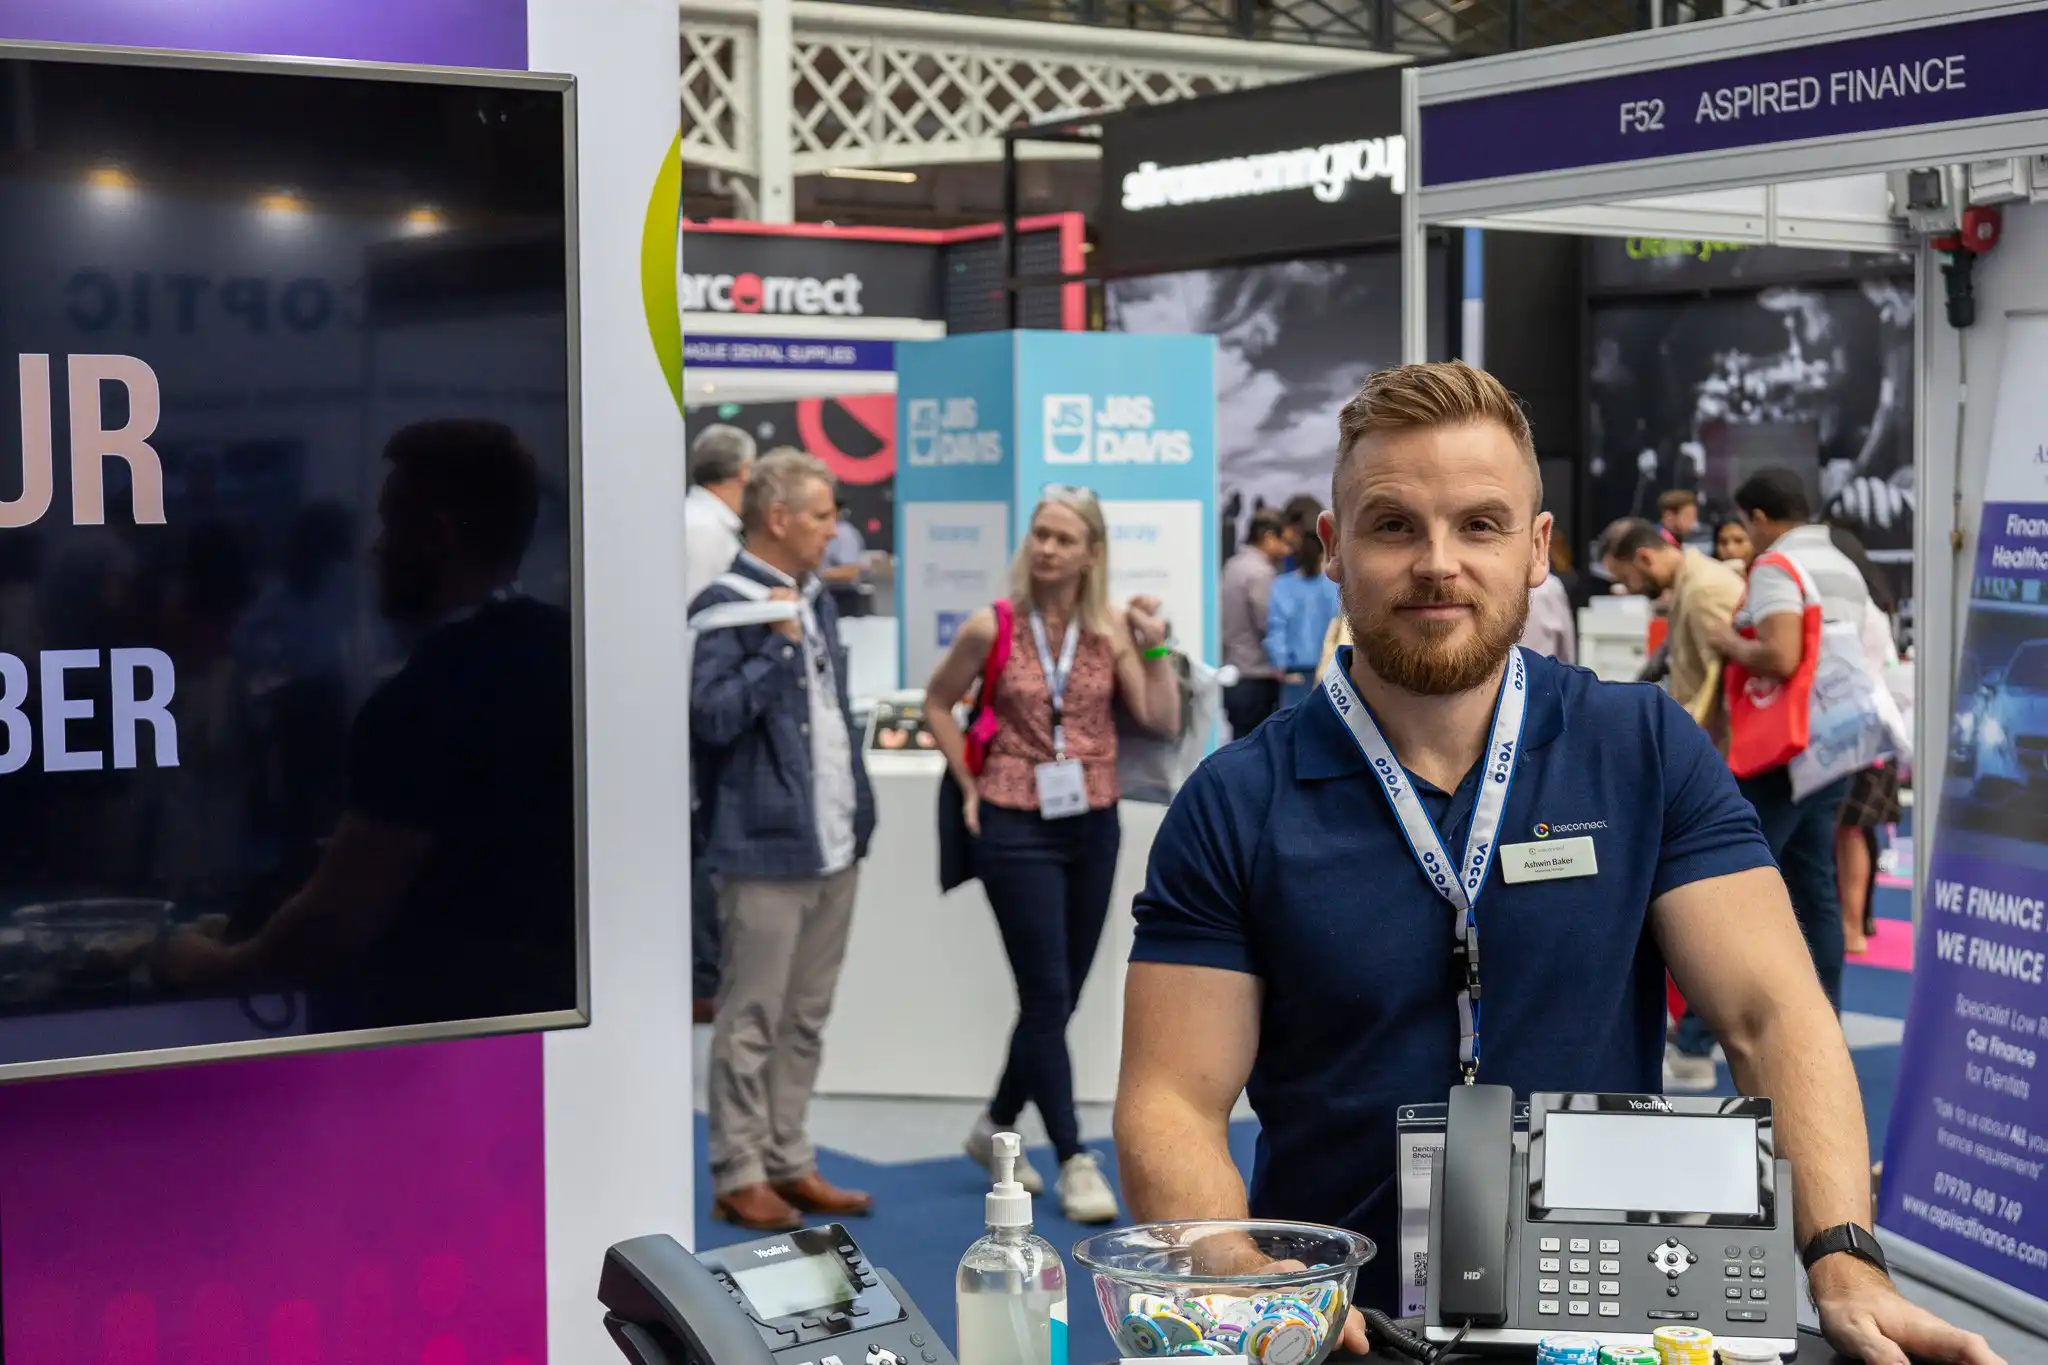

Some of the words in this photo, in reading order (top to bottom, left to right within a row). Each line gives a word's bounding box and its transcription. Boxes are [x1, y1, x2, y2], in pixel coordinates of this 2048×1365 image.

[1620, 98, 1664, 134] F52
[1695, 76, 1821, 124] ASPIRED
[1830, 55, 1966, 106] FINANCE
[730, 343, 784, 363] DENTAL
[786, 344, 857, 365] SUPPLIES
[1096, 430, 1193, 464] DAVIS
[1330, 683, 1351, 715] VOCO
[1375, 757, 1401, 798] VOCO
[1494, 740, 1513, 784] VOCO
[1552, 819, 1608, 833] iceconnect
[1423, 851, 1450, 897] VOCO
[1468, 843, 1488, 889] VOCO
[1524, 860, 1551, 869] Ashwin
[1552, 858, 1573, 866] Baker
[1935, 879, 1964, 914] WE
[1967, 886, 2045, 932] FINANCE
[1937, 929, 1965, 965] WE
[1968, 937, 2045, 985] FINANCE
[2011, 1010, 2036, 1033] Low
[1966, 1028, 1988, 1053] Car
[1989, 1035, 2036, 1069] Finance
[1966, 1061, 1982, 1084] for
[1984, 1066, 2029, 1100] Dentists
[1628, 1099, 1673, 1110] Yealink
[2010, 1124, 2027, 1147] ALL
[752, 1244, 791, 1259] Yealink
[1463, 1271, 1481, 1280] HD
